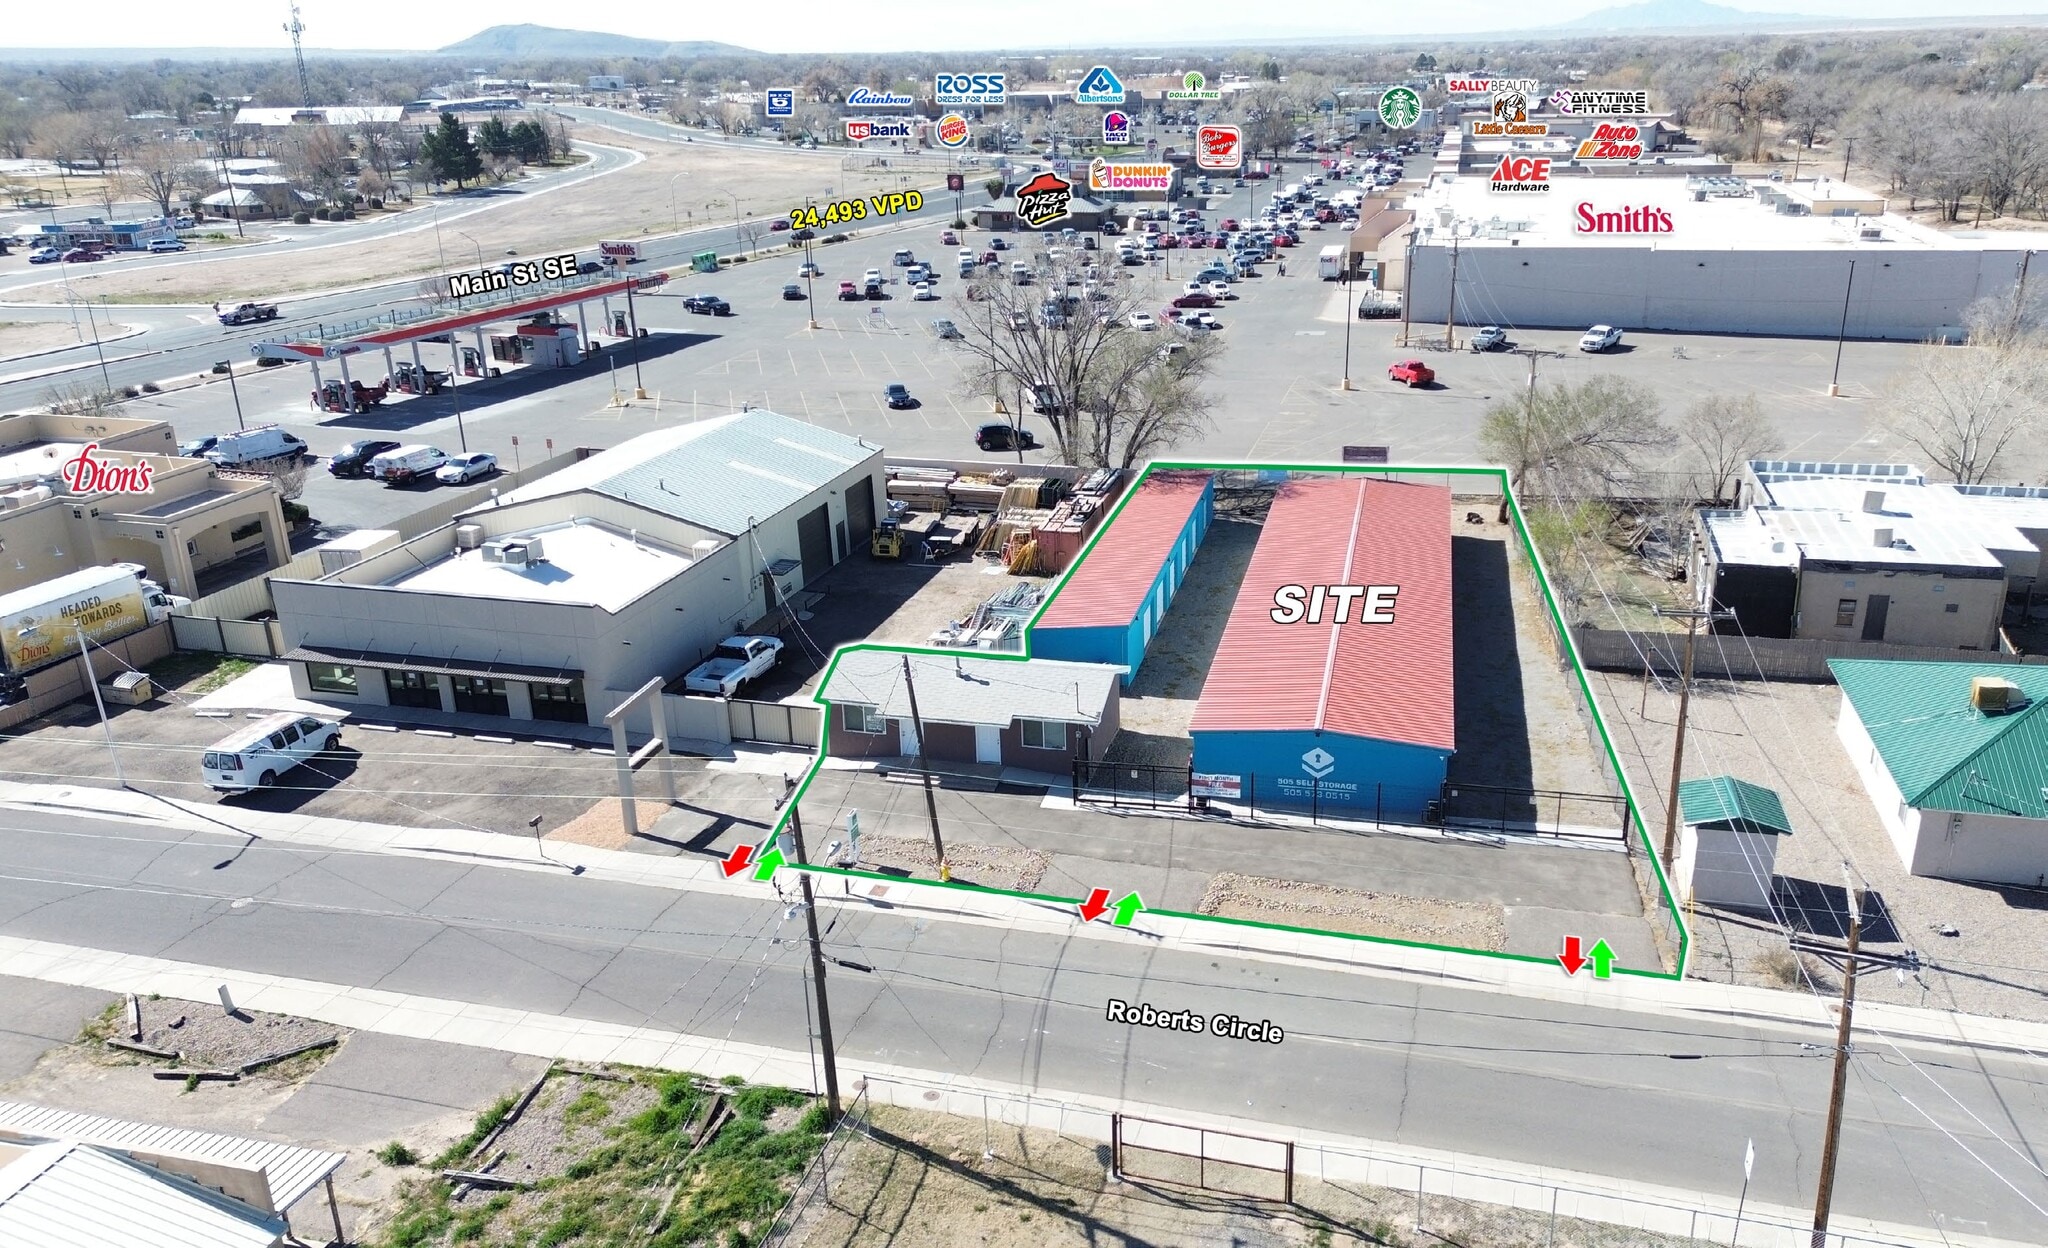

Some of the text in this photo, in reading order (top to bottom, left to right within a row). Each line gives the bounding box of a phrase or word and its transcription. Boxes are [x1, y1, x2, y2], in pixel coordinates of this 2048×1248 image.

[601, 242, 636, 256] Smith's
[60, 596, 101, 618] HEADED
[74, 602, 123, 626] TOWARDS
[1318, 780, 1358, 790] STORAGE
[1283, 788, 1302, 797] 505
[1325, 791, 1351, 801] 0515
